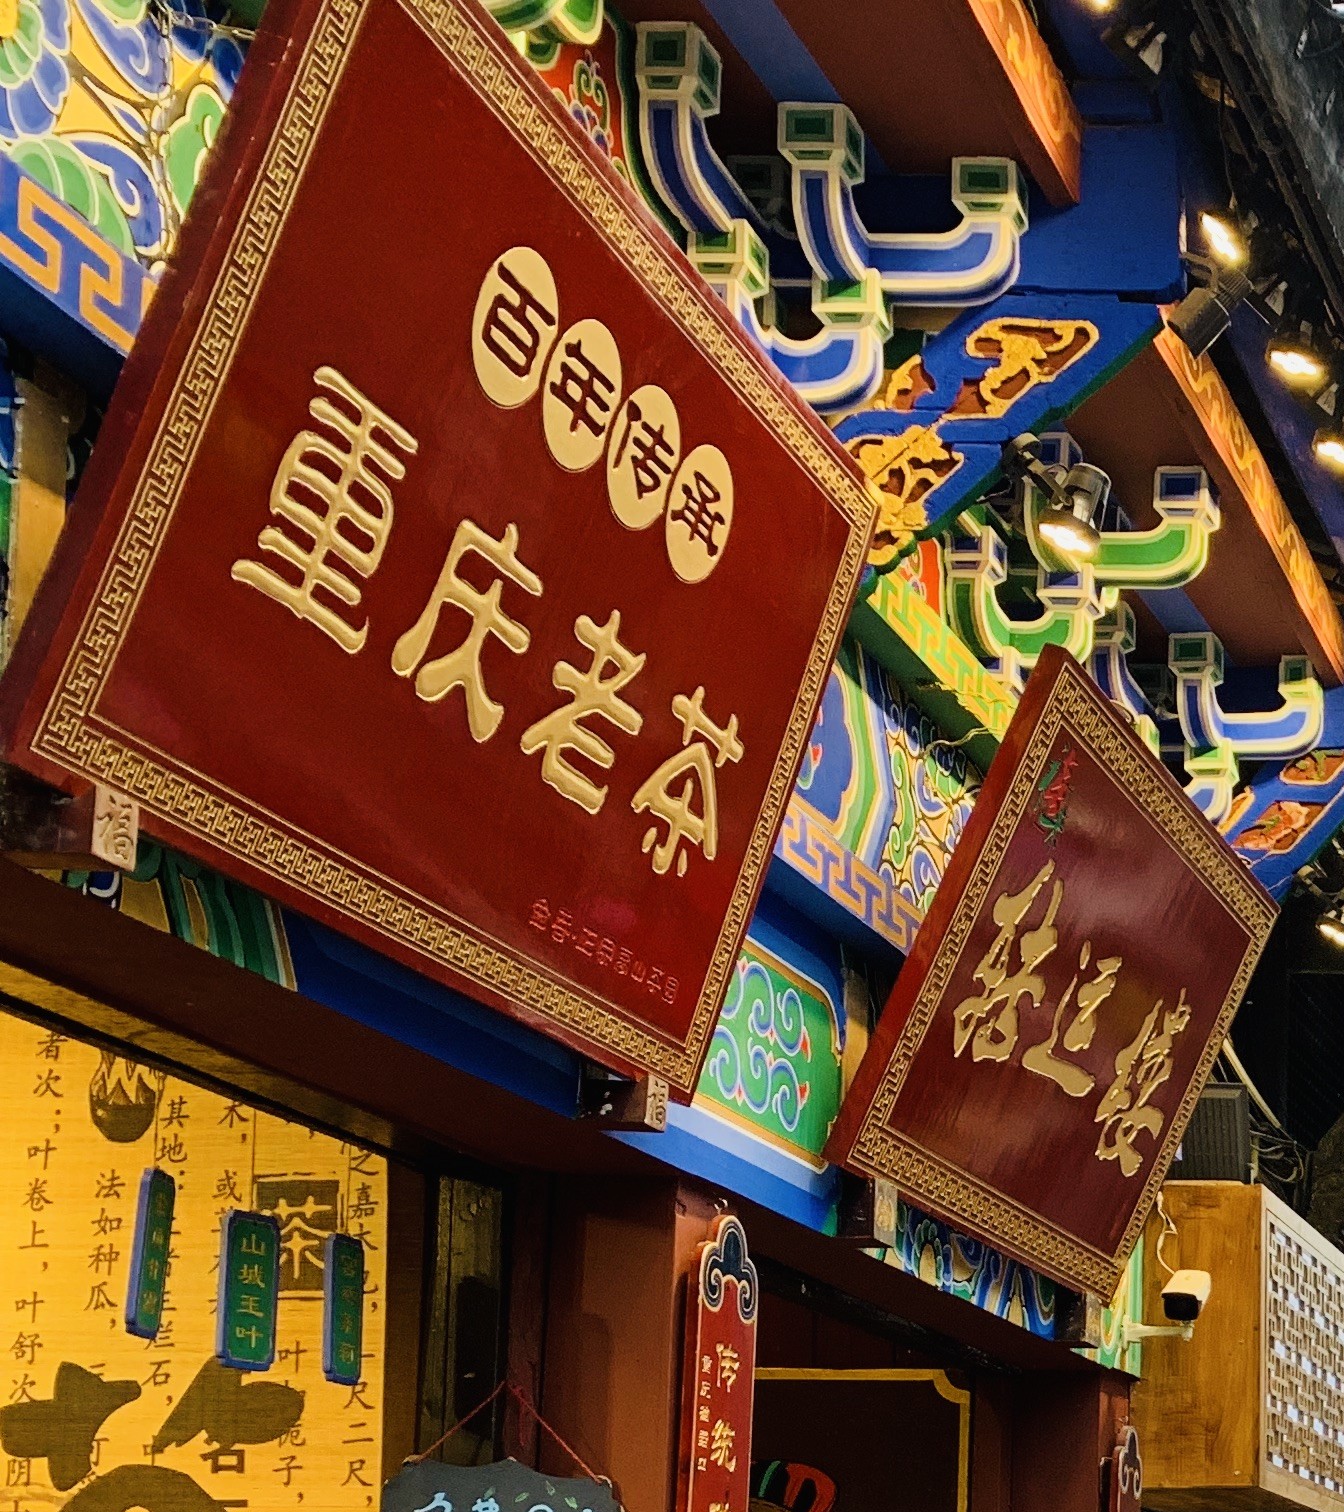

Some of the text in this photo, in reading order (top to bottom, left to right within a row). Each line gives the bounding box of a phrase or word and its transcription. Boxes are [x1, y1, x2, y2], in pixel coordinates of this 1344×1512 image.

[482, 262, 727, 562] 百年传承
[231, 364, 746, 879] 重庆老茶
